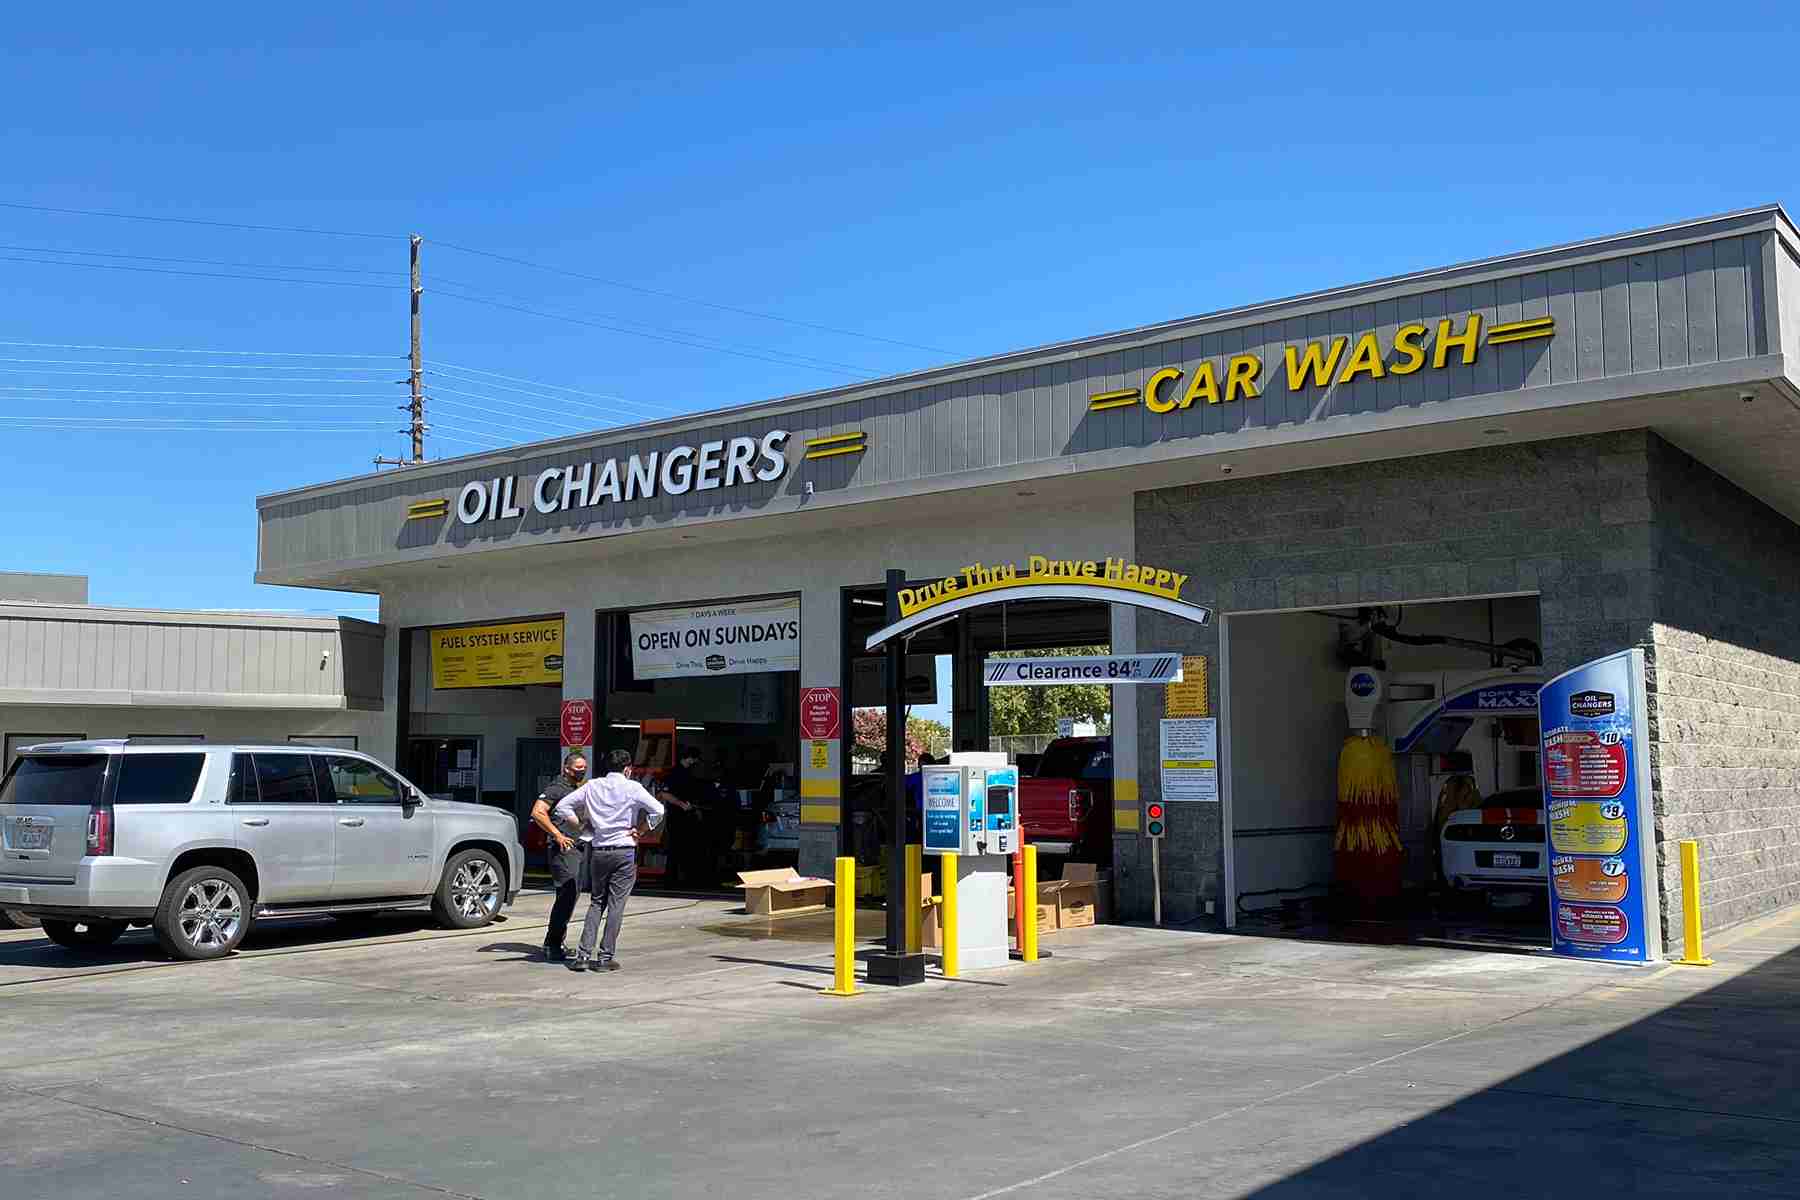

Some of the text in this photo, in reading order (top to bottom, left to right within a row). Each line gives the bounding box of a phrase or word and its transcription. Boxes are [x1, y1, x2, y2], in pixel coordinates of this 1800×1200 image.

[1144, 313, 1482, 413] CAR WASH
[457, 431, 791, 525] OIL CHANGERS
[898, 576, 958, 610] Drive
[960, 562, 1016, 588] Thru
[1029, 555, 1097, 578] Drive
[695, 610, 711, 618] DAYS
[717, 608, 736, 617] WEEK
[441, 629, 558, 648] FUEL SYSTEM SERVICE
[638, 621, 798, 650] OPEN ON SUNDAYS
[1016, 662, 1102, 681] Clearance
[808, 693, 831, 702] STOP
[1572, 700, 1612, 708] CHANGERS
[567, 705, 586, 713] STOP
[1606, 805, 1619, 817] $9
